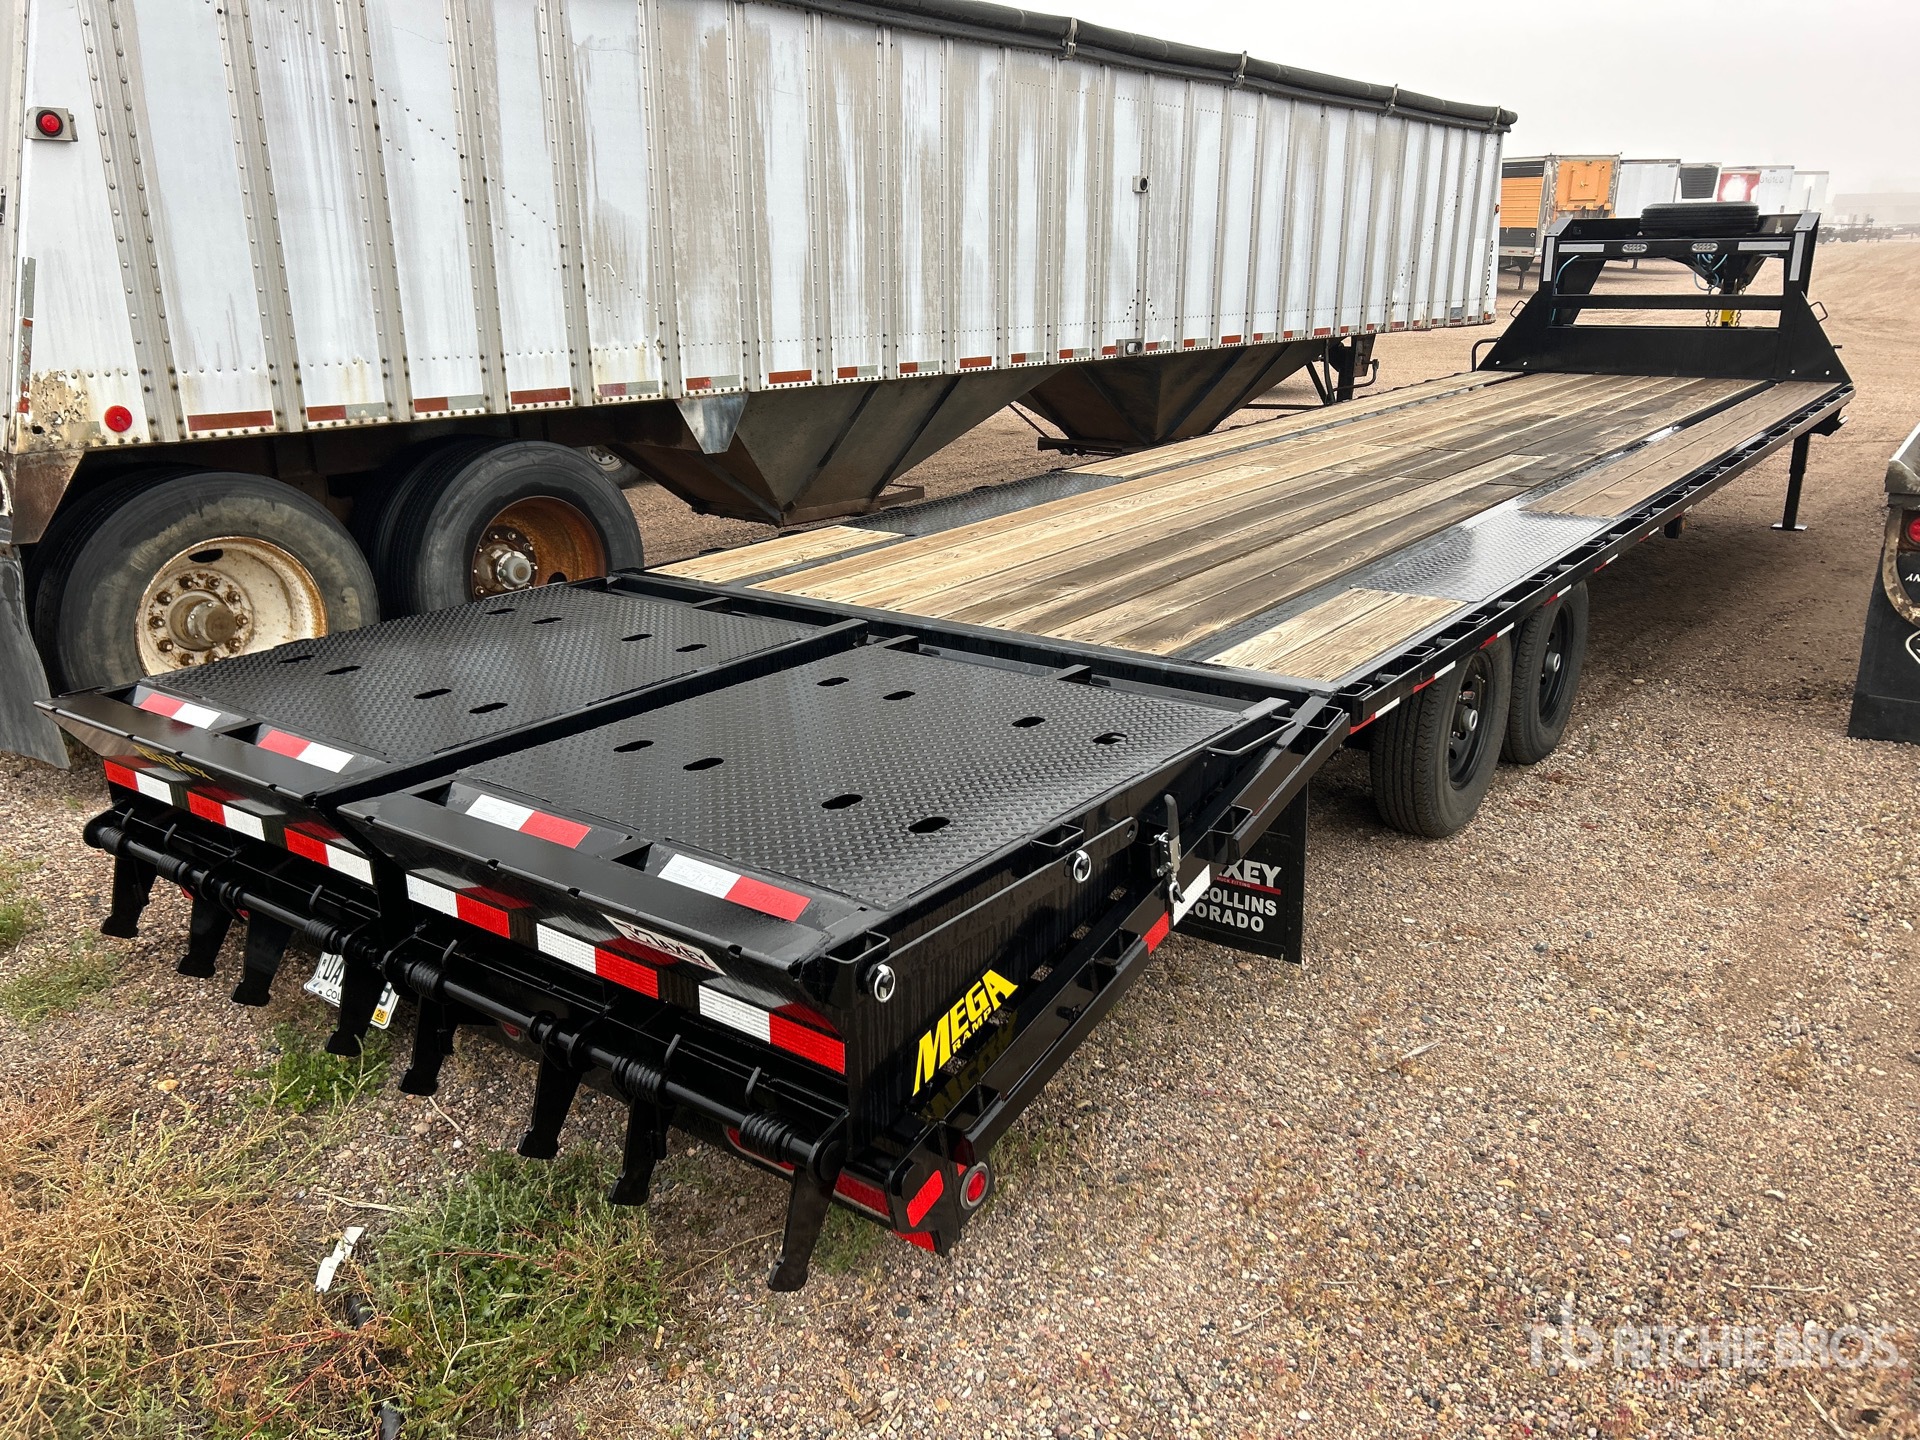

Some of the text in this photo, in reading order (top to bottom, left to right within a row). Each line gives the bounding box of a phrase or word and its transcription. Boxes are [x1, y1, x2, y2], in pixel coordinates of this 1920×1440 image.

[1219, 858, 1282, 888] XEY
[1187, 902, 1265, 933] ORADO
[912, 969, 1019, 1097] MEGA
[952, 1007, 992, 1054] RAMP
